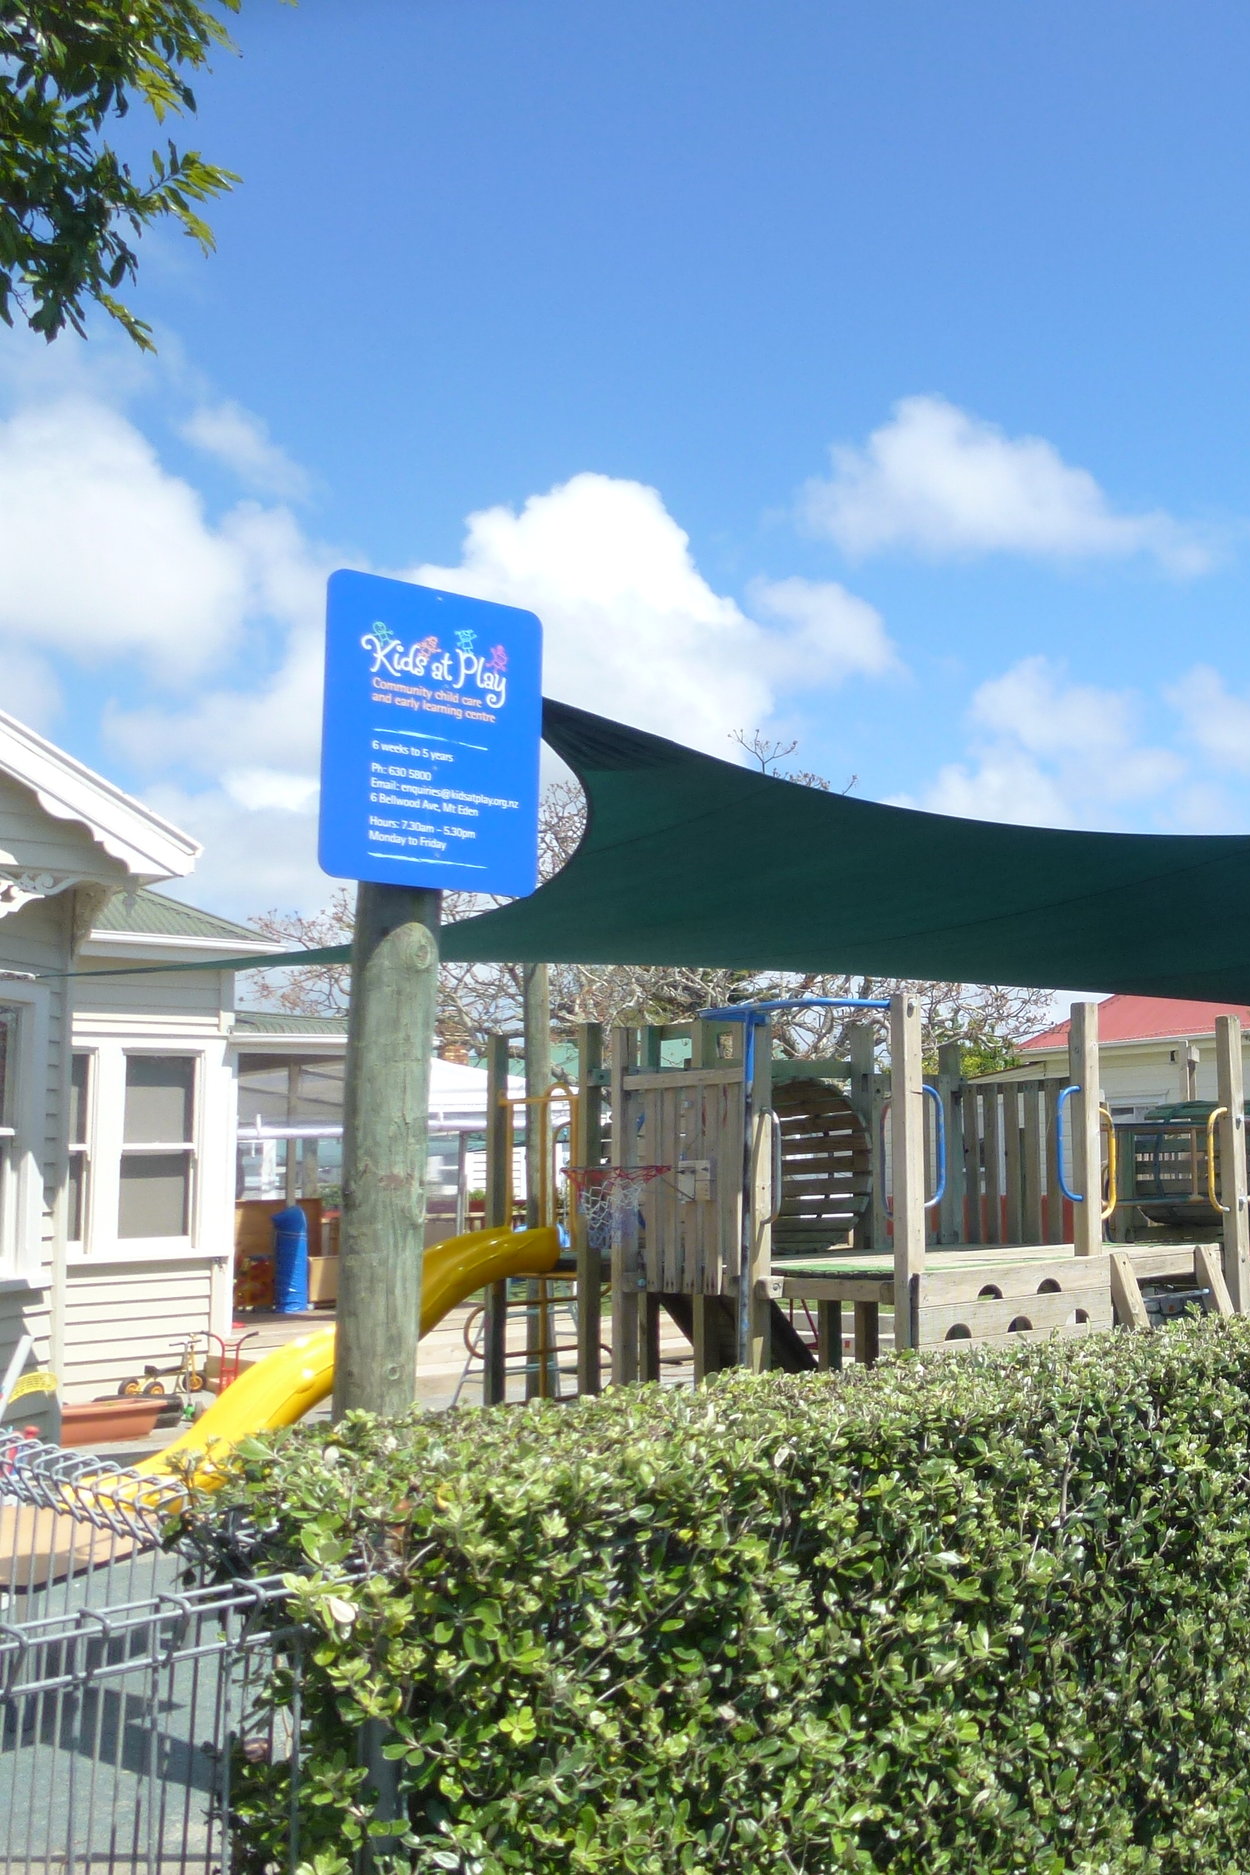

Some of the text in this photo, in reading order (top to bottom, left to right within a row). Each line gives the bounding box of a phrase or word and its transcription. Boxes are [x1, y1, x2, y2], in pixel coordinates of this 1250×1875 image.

[361, 634, 506, 708] Kids at Play
[372, 677, 482, 708] Community child care
[372, 692, 496, 723] and early learning centre
[372, 740, 453, 762] 6 weeks to 5 years
[371, 762, 431, 781] Ph: 630 5800
[371, 777, 400, 791] Email:
[370, 793, 377, 802] 6
[379, 793, 420, 809] Bellwood
[442, 802, 456, 813] Mt
[457, 805, 479, 816] Eden
[369, 816, 400, 829] Hours:
[401, 820, 434, 833] 7.30am
[443, 825, 476, 840] 5.30pm
[369, 830, 447, 851] Monday to Friday
